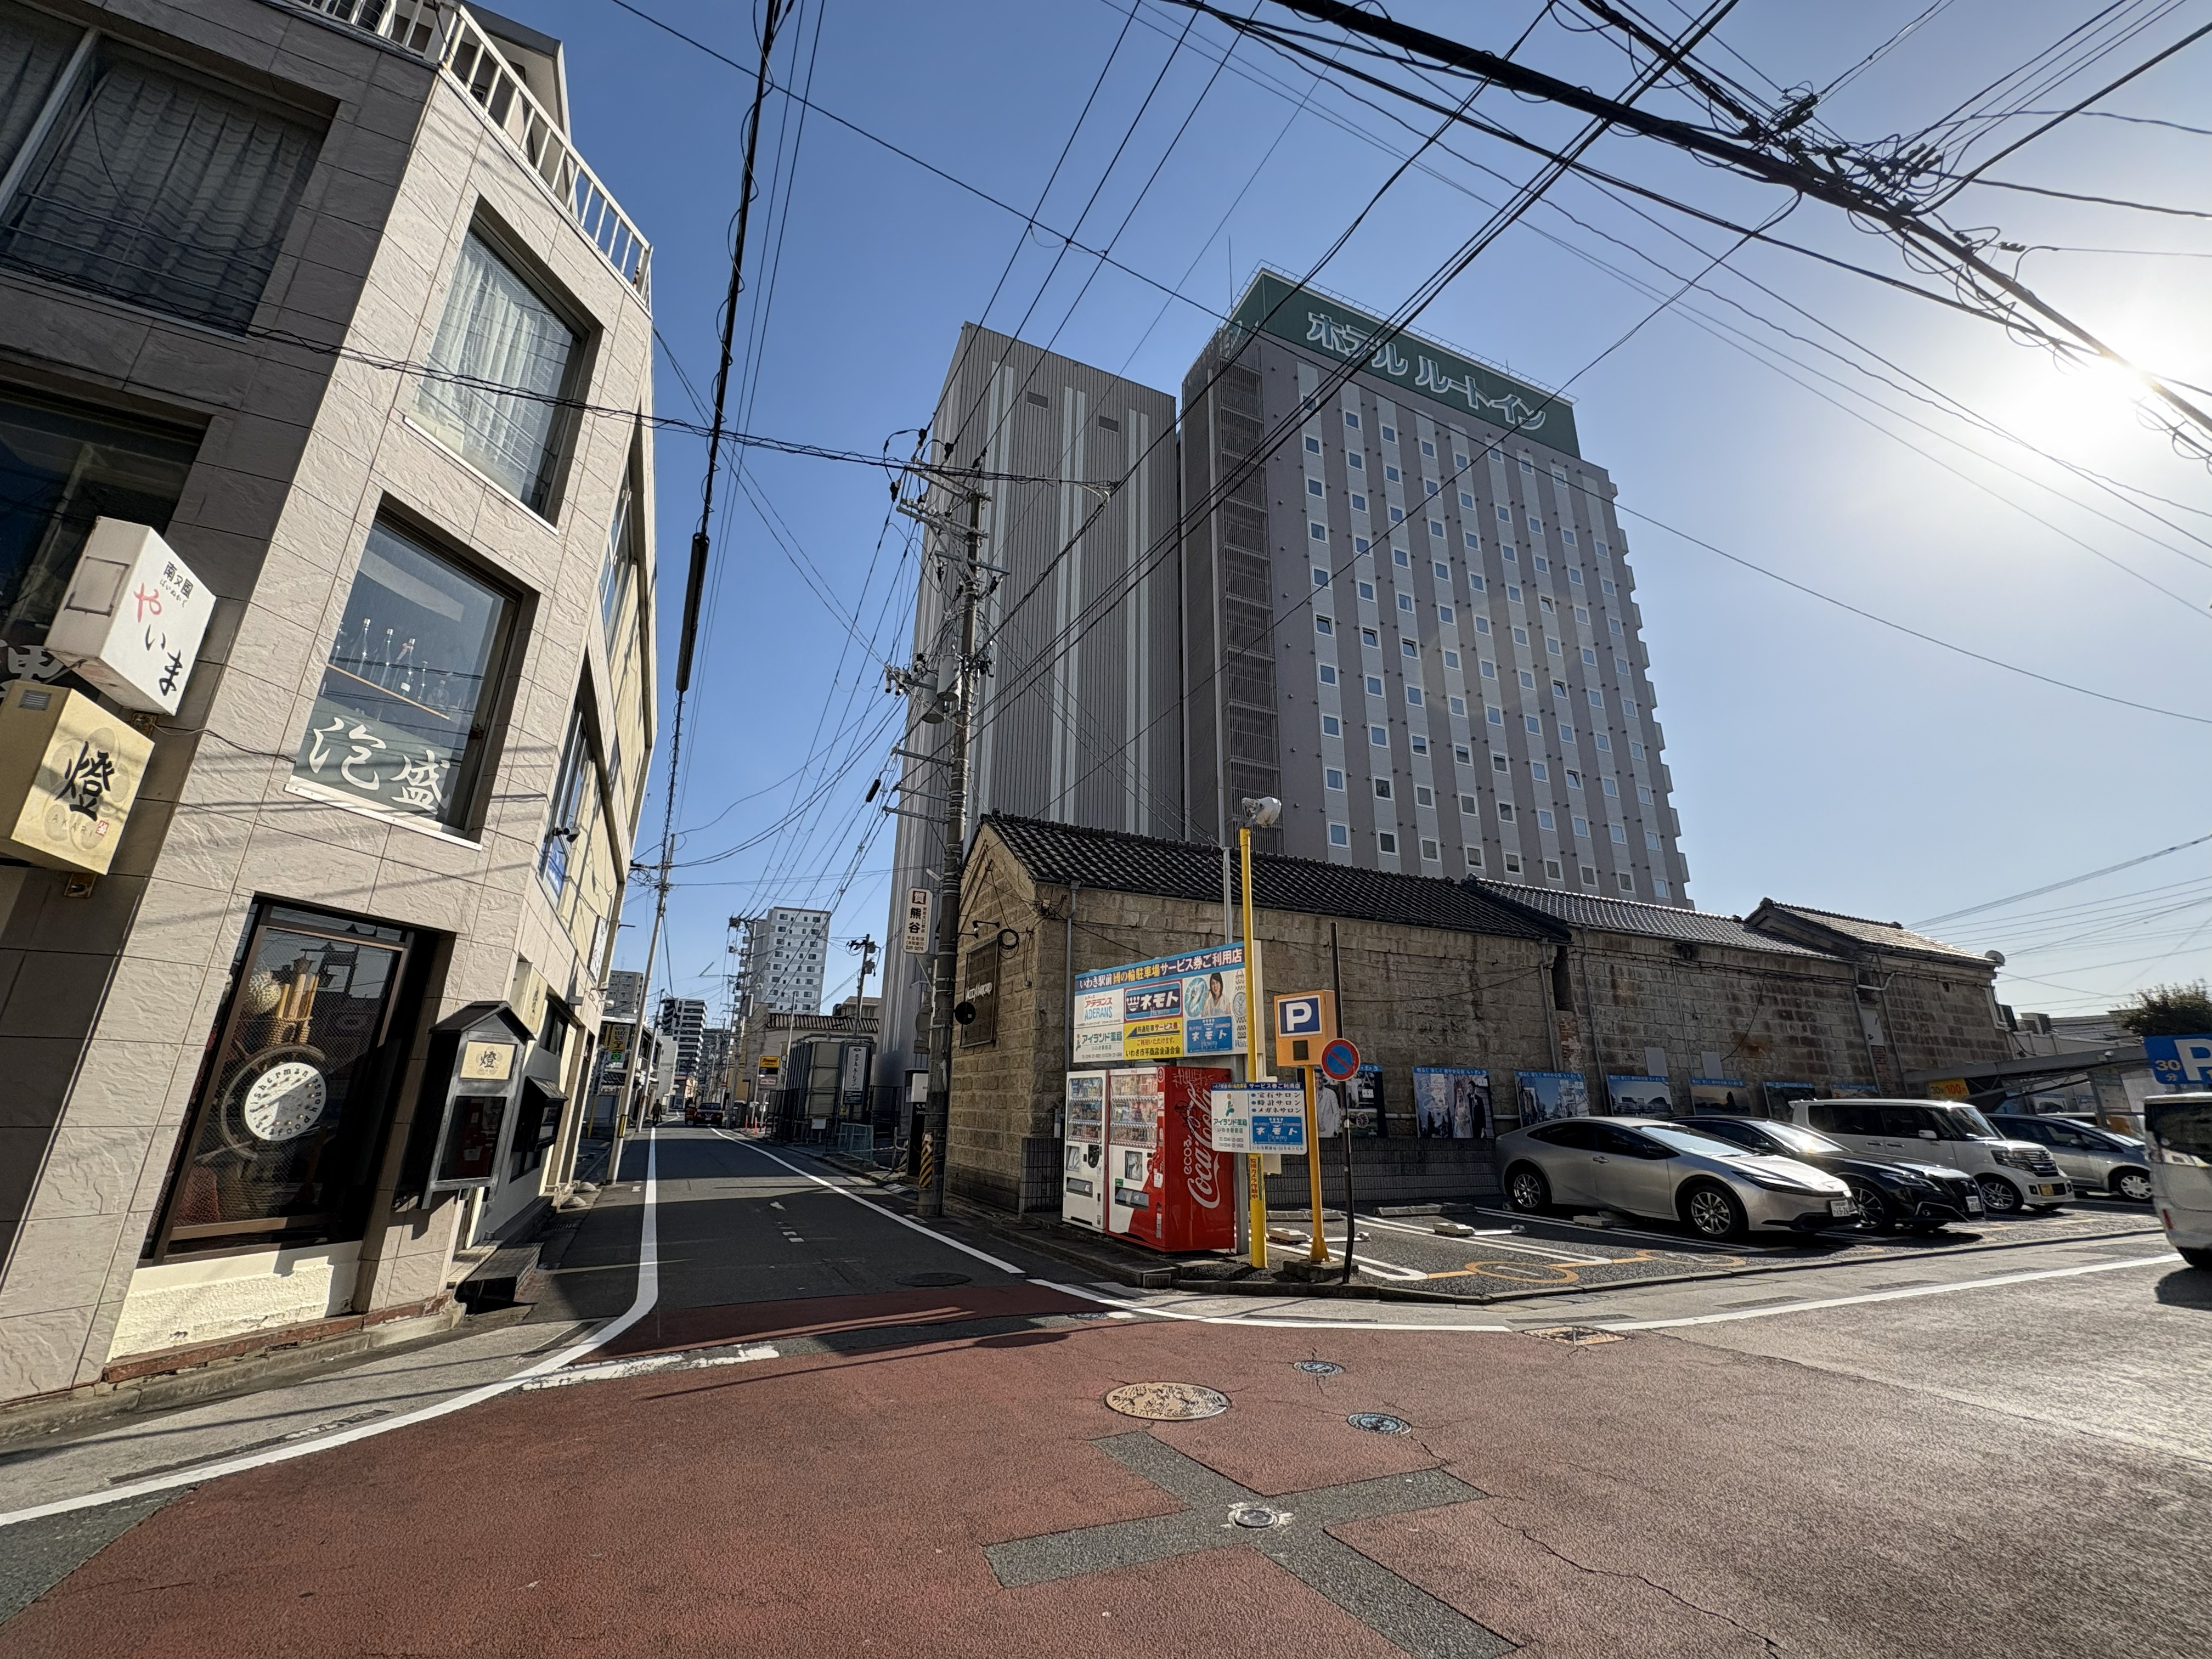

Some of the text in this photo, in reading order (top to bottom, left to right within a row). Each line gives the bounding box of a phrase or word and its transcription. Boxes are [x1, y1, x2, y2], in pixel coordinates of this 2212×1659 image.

[1306, 311, 1408, 376] ホテル
[1415, 354, 1547, 431] ルートイン
[133, 583, 183, 696] やいま
[54, 741, 115, 822] 燈
[52, 814, 94, 837] AKARI
[909, 907, 922, 933] 熊谷
[1085, 997, 1113, 1008] アデランス
[1140, 991, 1179, 1010] ネモト
[1084, 1006, 1113, 1022] ADERANS
[1286, 1001, 1312, 1031] P
[1082, 1031, 1122, 1044] アイランド薬局
[1191, 1029, 1228, 1042] ネモト
[479, 1050, 497, 1068] 燈
[2155, 1059, 2181, 1071] 30
[2174, 1038, 2212, 1081] P
[1256, 1126, 1298, 1135] ネモト
[1187, 1081, 1221, 1209] Coca-Cola
